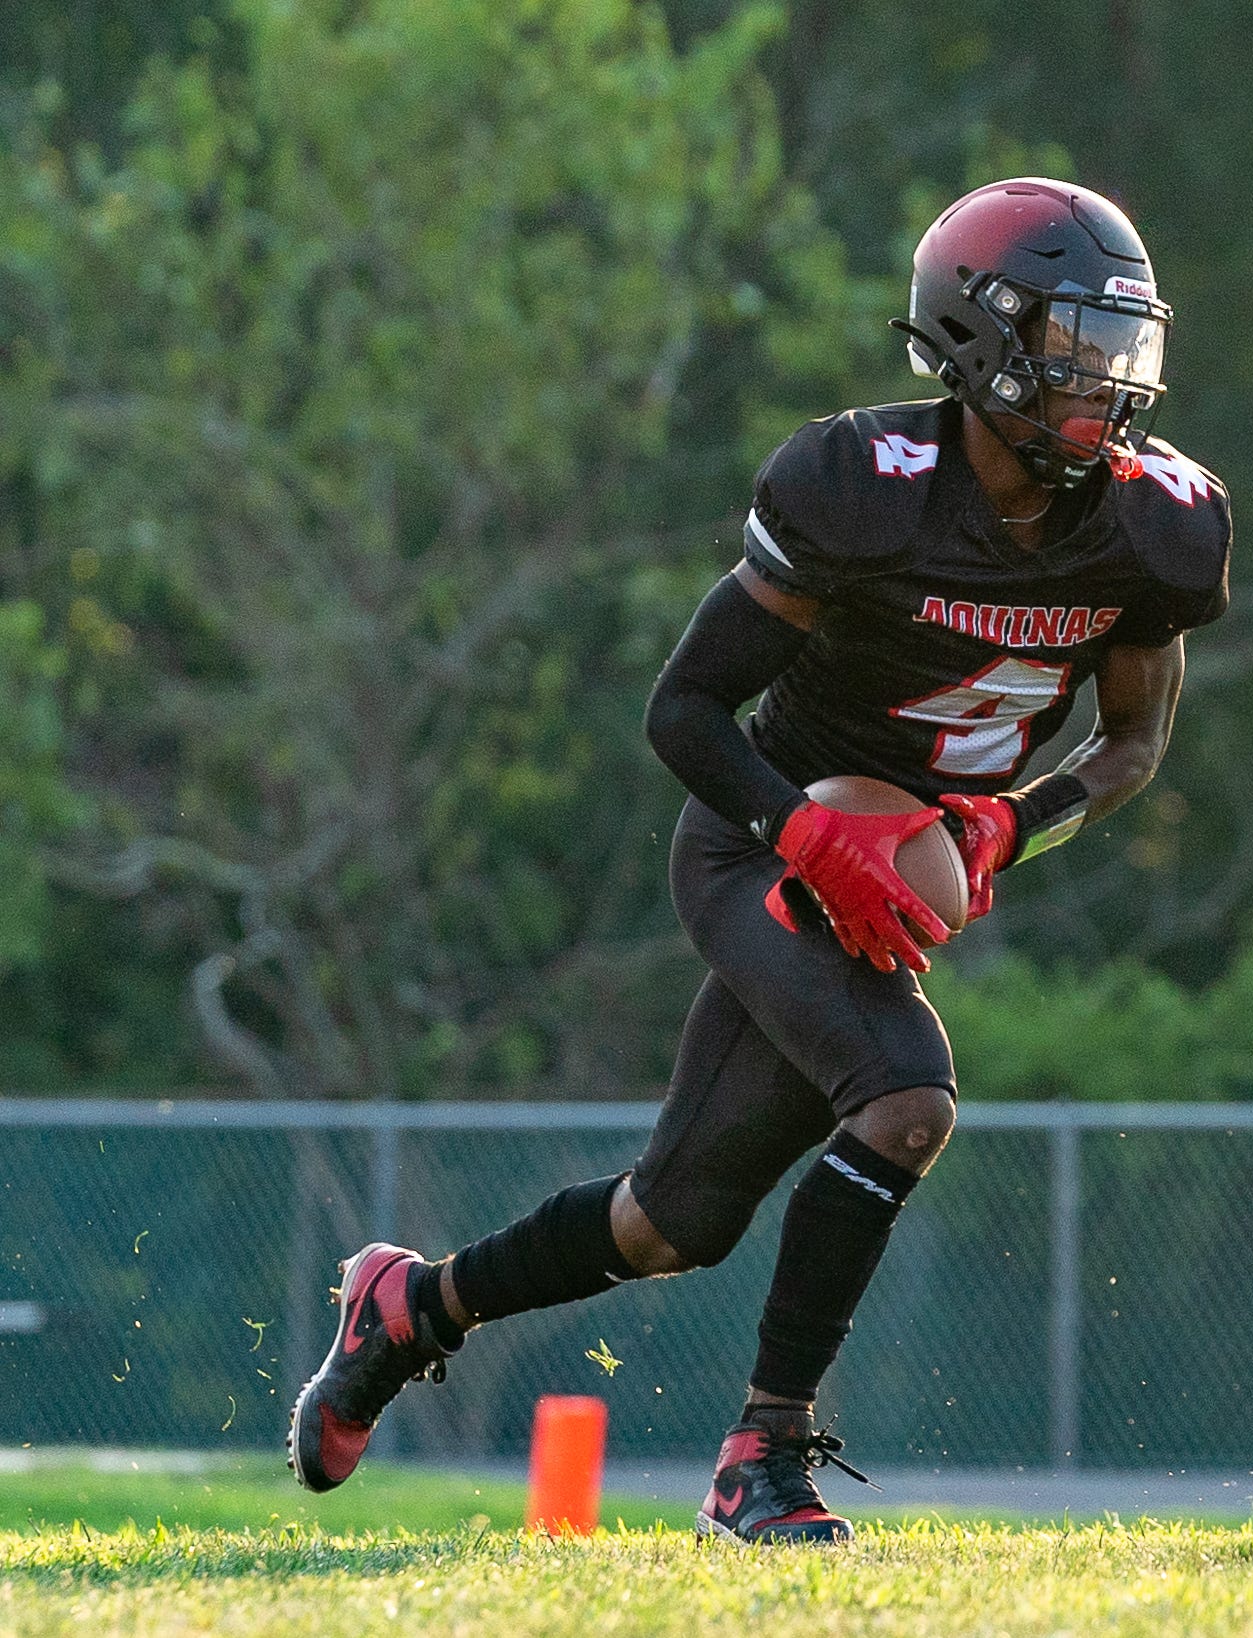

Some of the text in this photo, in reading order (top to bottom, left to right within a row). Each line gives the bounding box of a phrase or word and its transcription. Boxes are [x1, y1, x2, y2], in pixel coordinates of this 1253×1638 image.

[870, 432, 940, 480] 4
[1137, 453, 1211, 508] 4
[912, 596, 1123, 647] AQUINAS
[888, 655, 1072, 778] 4
